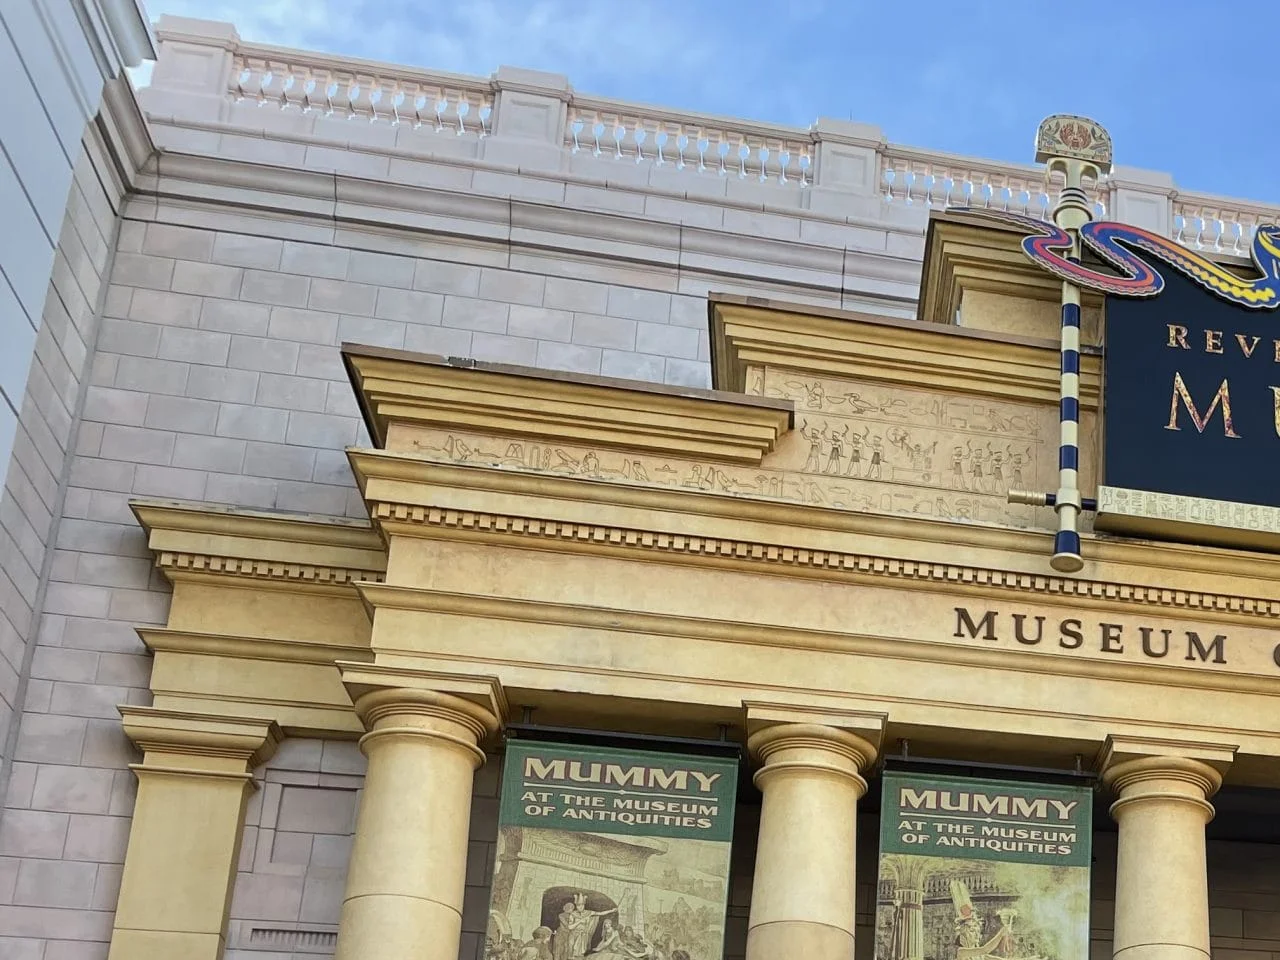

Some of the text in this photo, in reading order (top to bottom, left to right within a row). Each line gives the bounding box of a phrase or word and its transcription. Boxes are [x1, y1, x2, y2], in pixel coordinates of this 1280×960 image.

[953, 607, 1227, 664] MUSEUM
[524, 757, 721, 792] MUMMY
[520, 791, 718, 816] AT THE MUSEUM
[899, 788, 1078, 820] MUMMY
[524, 805, 712, 829] OF ANTIQUITIES
[898, 820, 1077, 843] AT THE MUSEUM
[901, 833, 1072, 855] OF ANTIQUITIES
